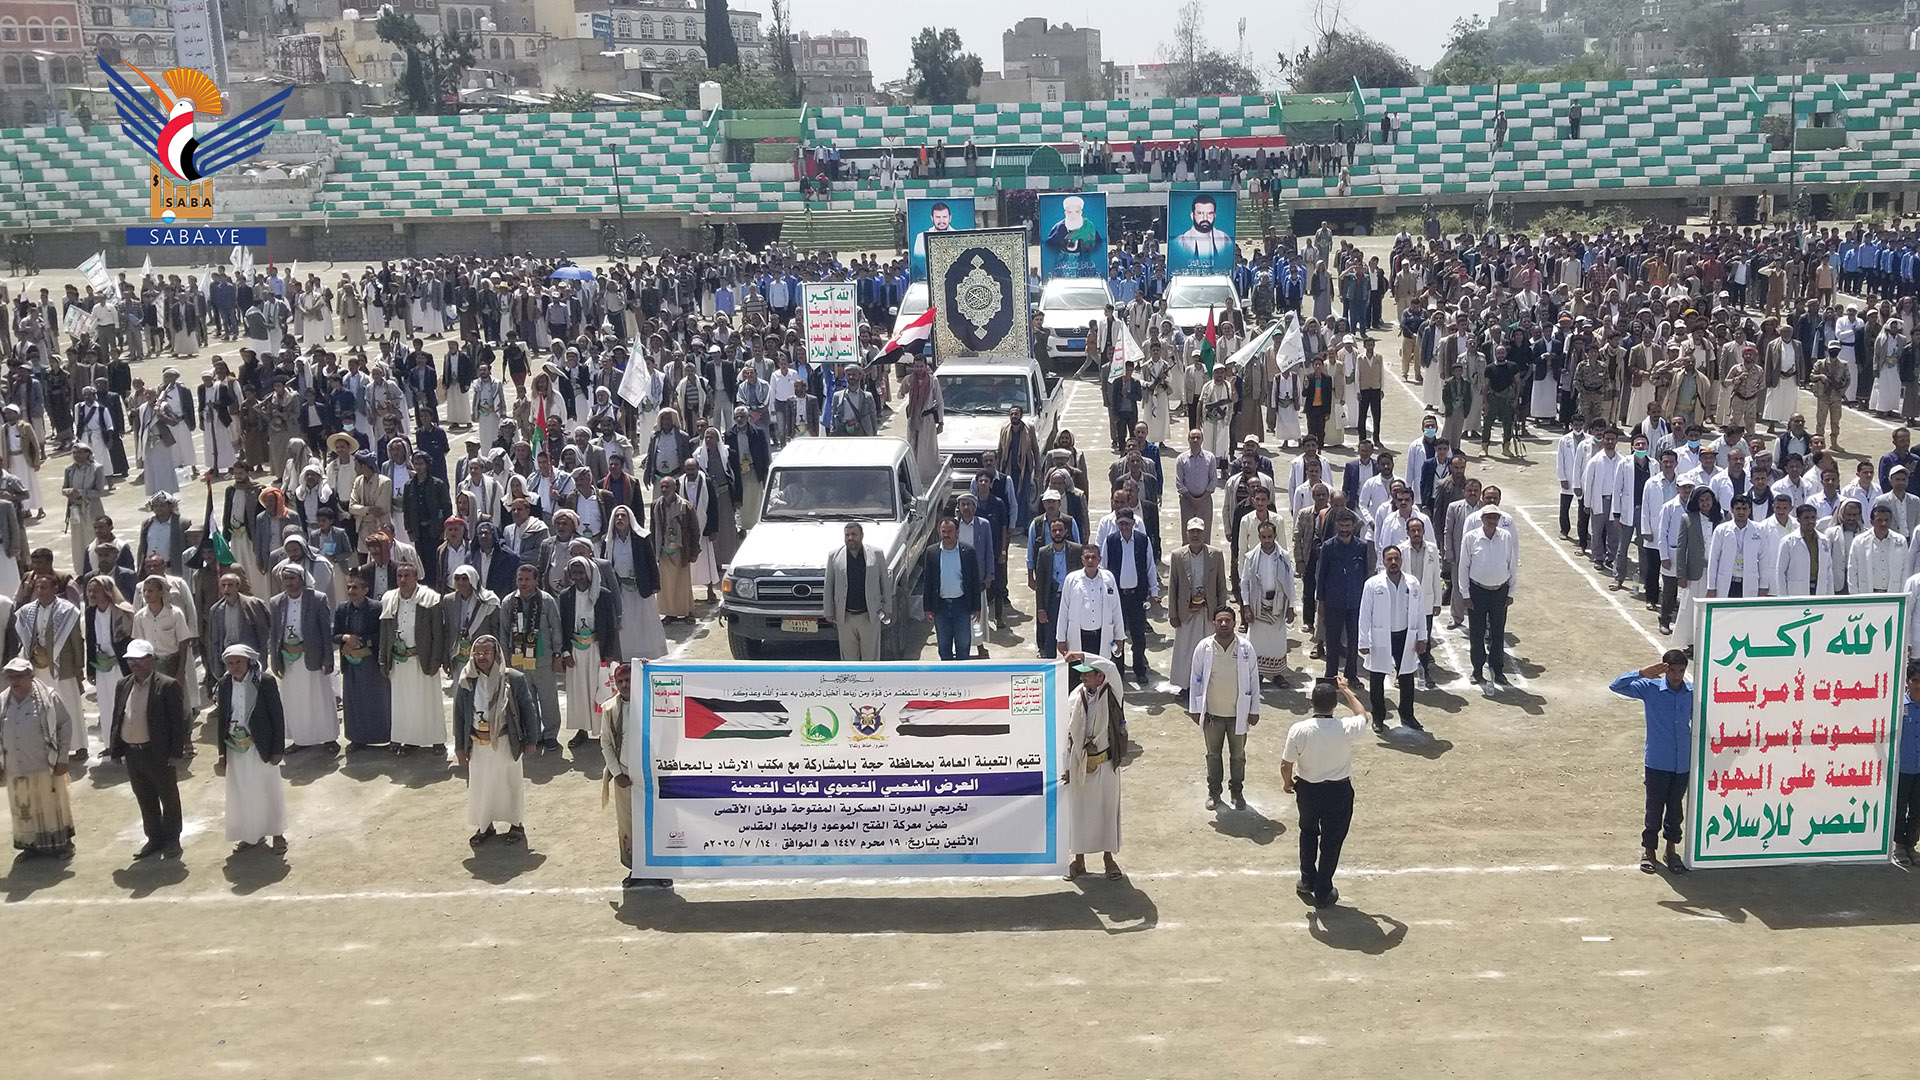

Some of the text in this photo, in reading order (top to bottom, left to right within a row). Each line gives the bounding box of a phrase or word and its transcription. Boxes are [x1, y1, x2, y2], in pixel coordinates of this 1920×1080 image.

[836, 288, 853, 300] الله
[1713, 609, 1893, 671] الله أكبر
[1713, 668, 1889, 709] الموت لأمريكا
[1710, 717, 1886, 754] الموت لإسرائيل
[656, 754, 1041, 774] تقيم التعبئة العامة بمحافظة حجة بالمشاركة مع مكتب الارشاد بالمحافظة
[730, 778, 979, 798] العرض الشعبي التعبوي لقوات التعبئة
[1707, 759, 1883, 798] اللعنة على اليهود
[714, 803, 968, 816] لخريجي الدورات العسكرية المفتوحة طوفان الأقصى
[739, 820, 948, 833] ضمن معركة الفتح الموعود والجهاد المقدس
[1706, 796, 1879, 852] النصر للإسلام
[782, 838, 817, 849] الموافق
[943, 836, 979, 848] الاثنين
